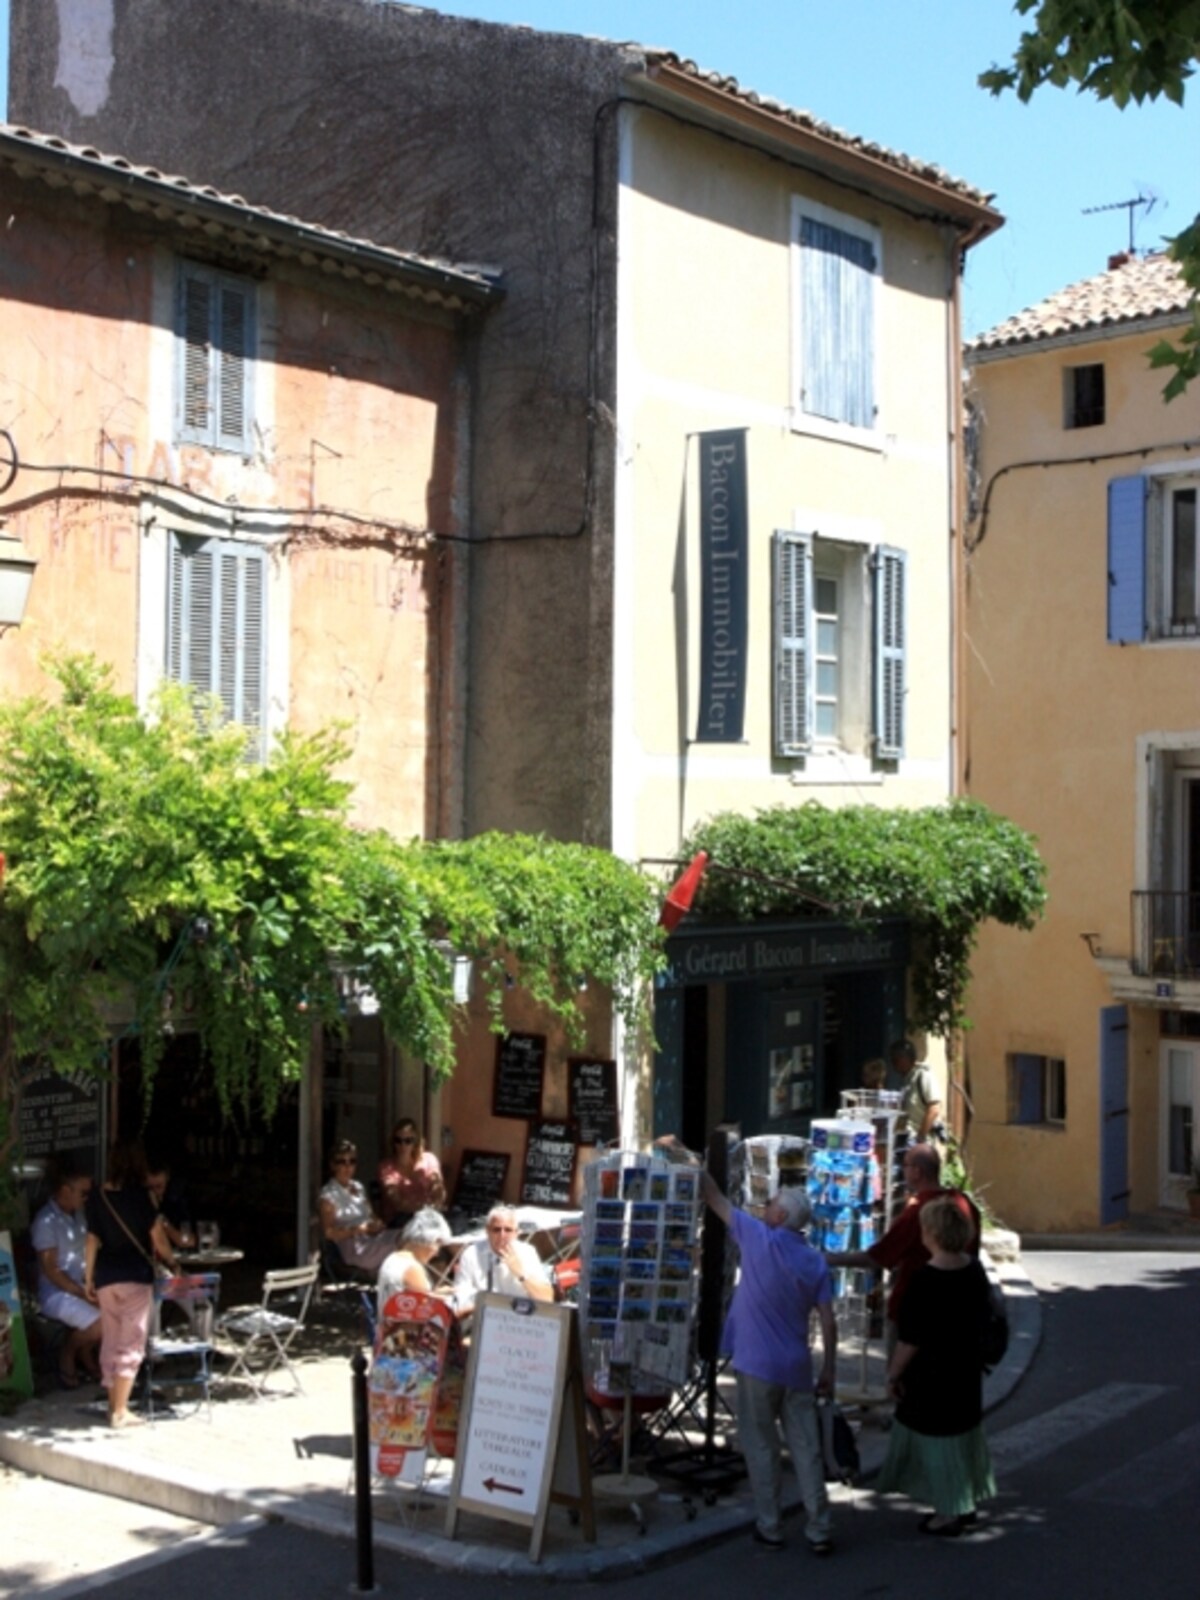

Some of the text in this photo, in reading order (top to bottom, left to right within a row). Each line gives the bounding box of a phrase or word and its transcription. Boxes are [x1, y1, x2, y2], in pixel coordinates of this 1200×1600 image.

[707, 442, 739, 735] Bacon Immobilier
[686, 935, 893, 974] Gérard Bacon Immobilier
